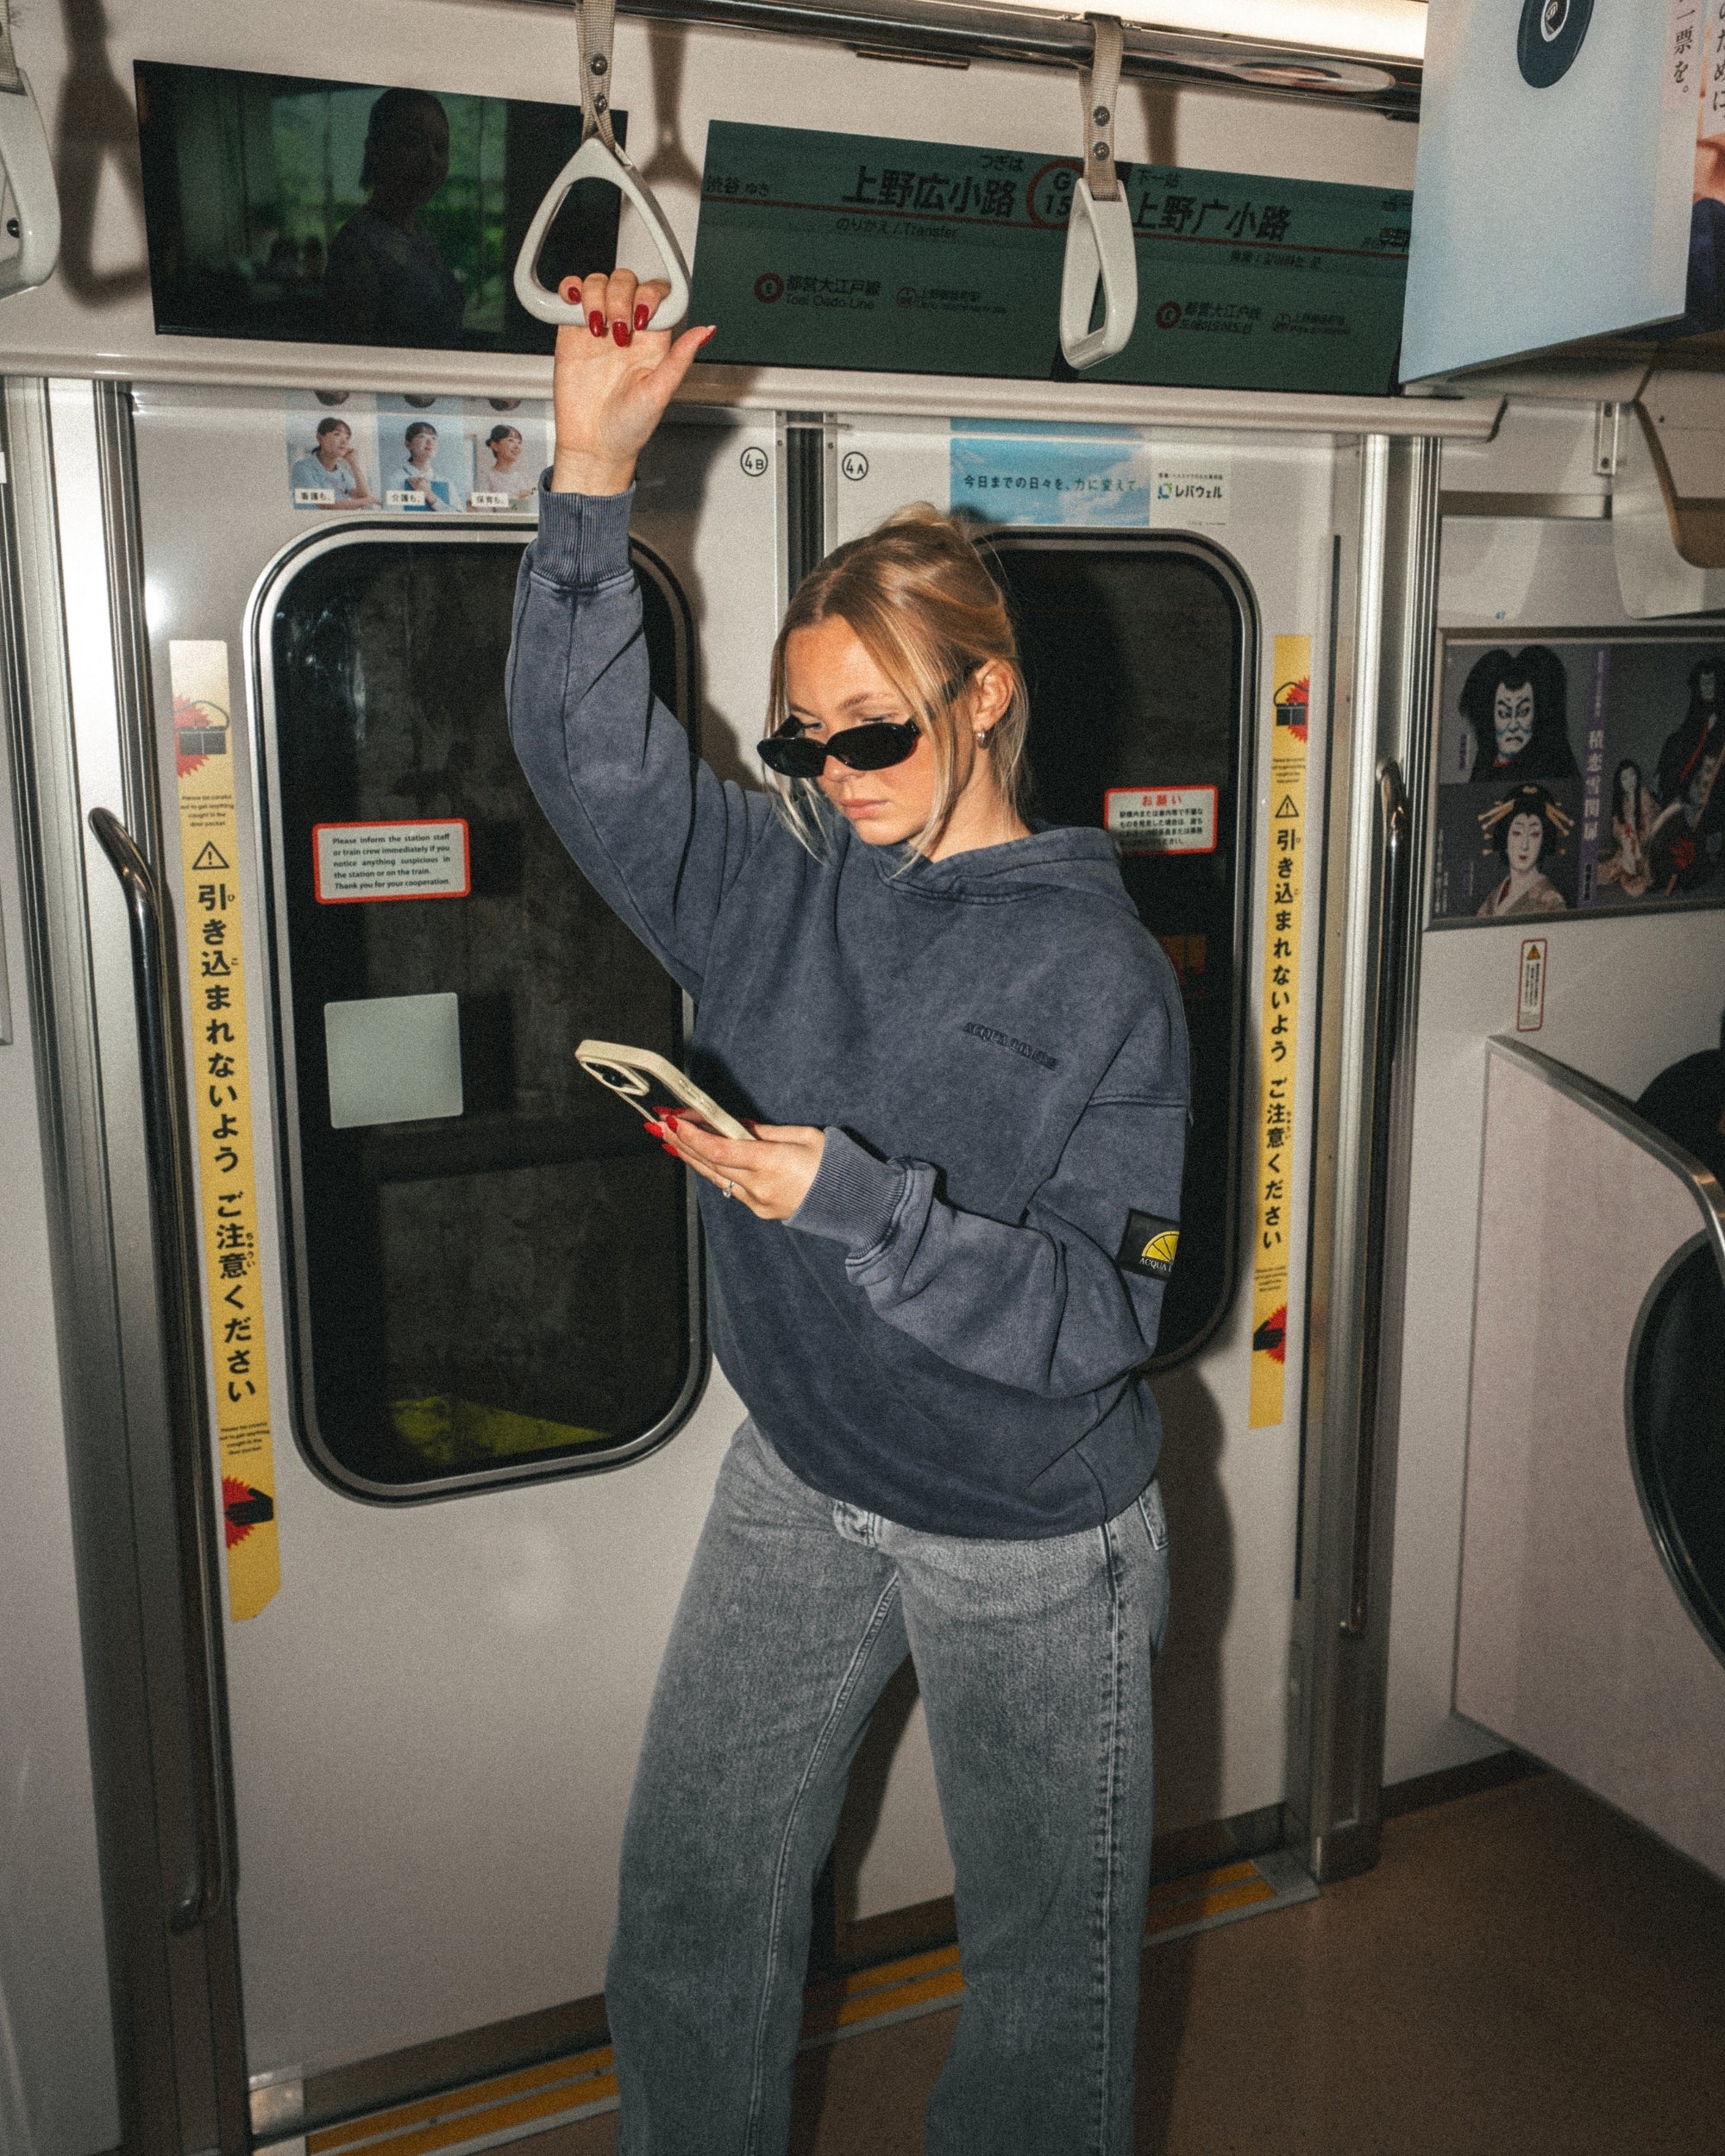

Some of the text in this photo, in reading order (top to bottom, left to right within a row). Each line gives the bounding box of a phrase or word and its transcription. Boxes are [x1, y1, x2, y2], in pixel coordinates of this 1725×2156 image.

[1672, 0, 1696, 93] 一票を。
[979, 154, 1025, 172] つぎは
[1053, 171, 1071, 191] G
[842, 165, 1019, 218] 上野広小路
[835, 216, 888, 235] のりかえ
[1132, 191, 1292, 241] 上野广小路
[744, 454, 765, 471] 4B
[845, 458, 865, 474] 4A
[1176, 485, 1223, 499] レバウェル
[1142, 793, 1182, 807] お願い
[382, 845, 428, 855] immediately
[362, 859, 396, 868] anything
[405, 878, 449, 886] cooperation.
[1270, 829, 1296, 1063] 引き込まれないよう
[197, 882, 240, 1174] 引き込まれないよう
[1010, 1038, 1057, 1070] LIMO
[1262, 1077, 1288, 1250] ご注意ください
[1138, 1257, 1167, 1271] ACQUA
[216, 1192, 256, 1404] ご注意ください
